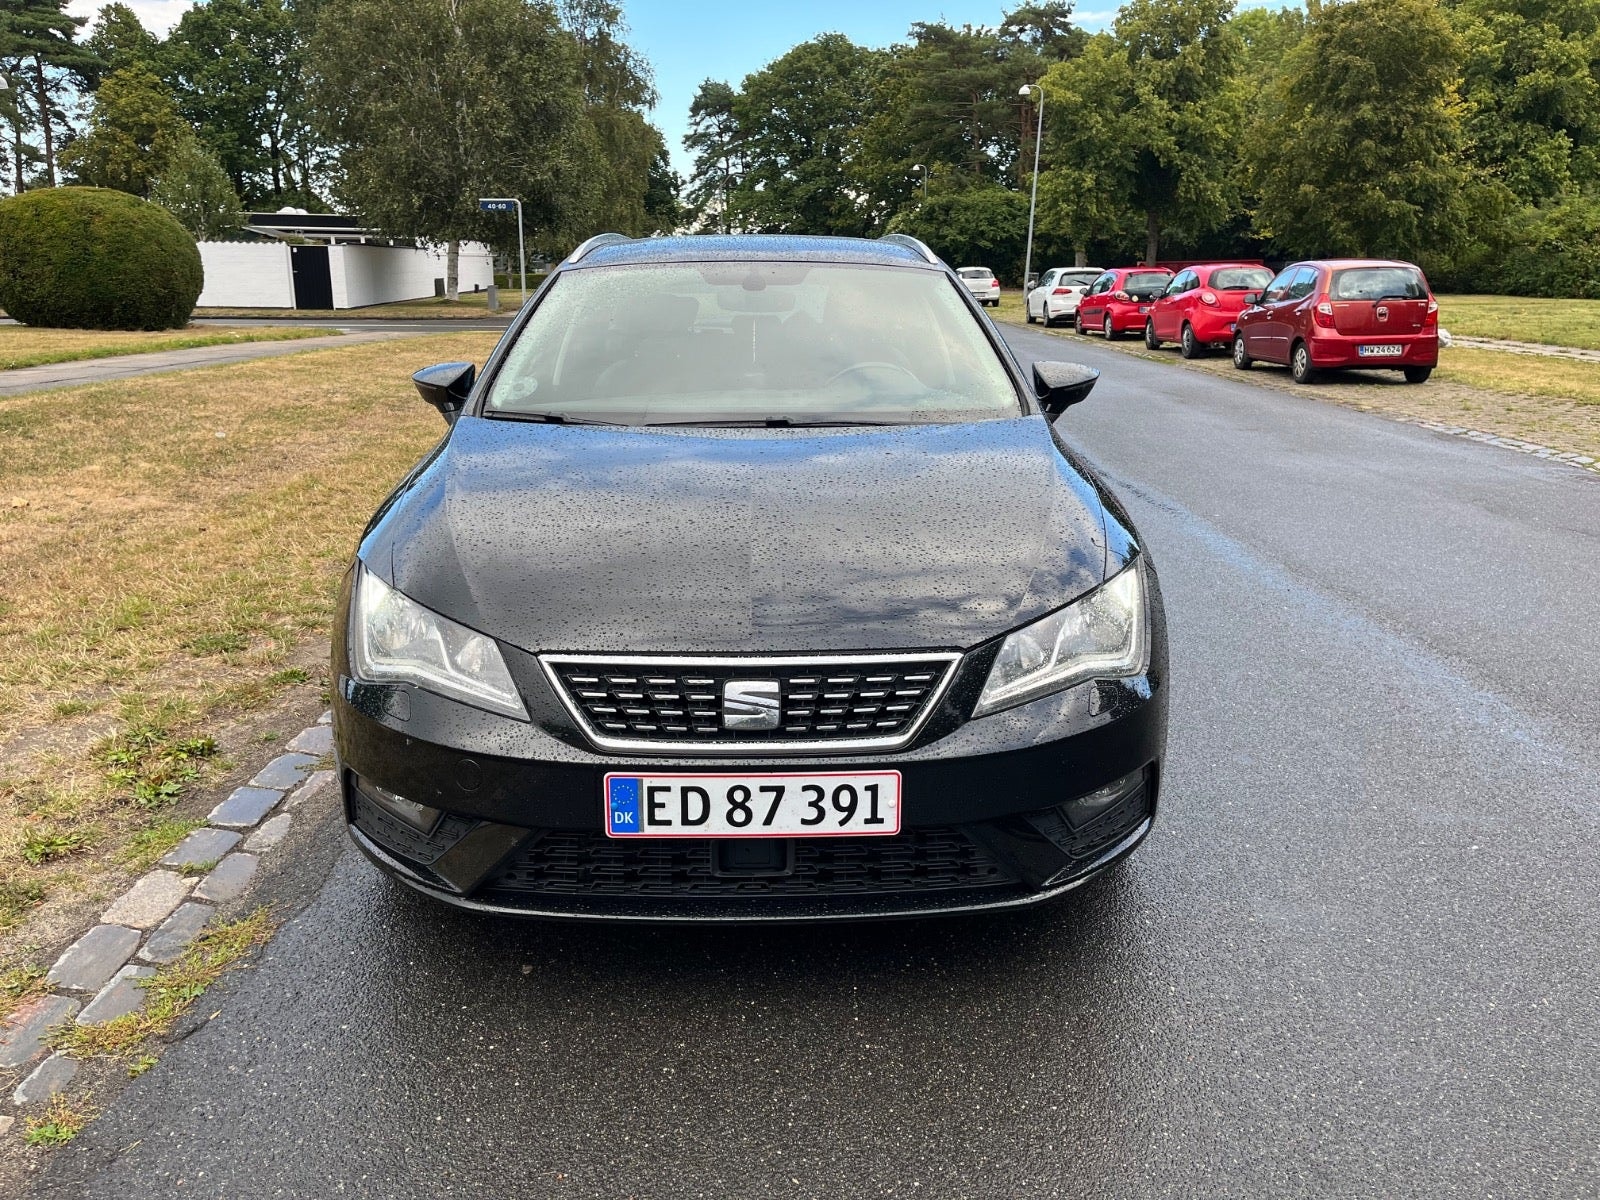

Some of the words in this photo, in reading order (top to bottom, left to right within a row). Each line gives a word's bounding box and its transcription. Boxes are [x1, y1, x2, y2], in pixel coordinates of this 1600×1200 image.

[614, 811, 634, 824] DK
[646, 785, 711, 826] ED
[725, 784, 786, 828] 87
[799, 783, 885, 827] 391
